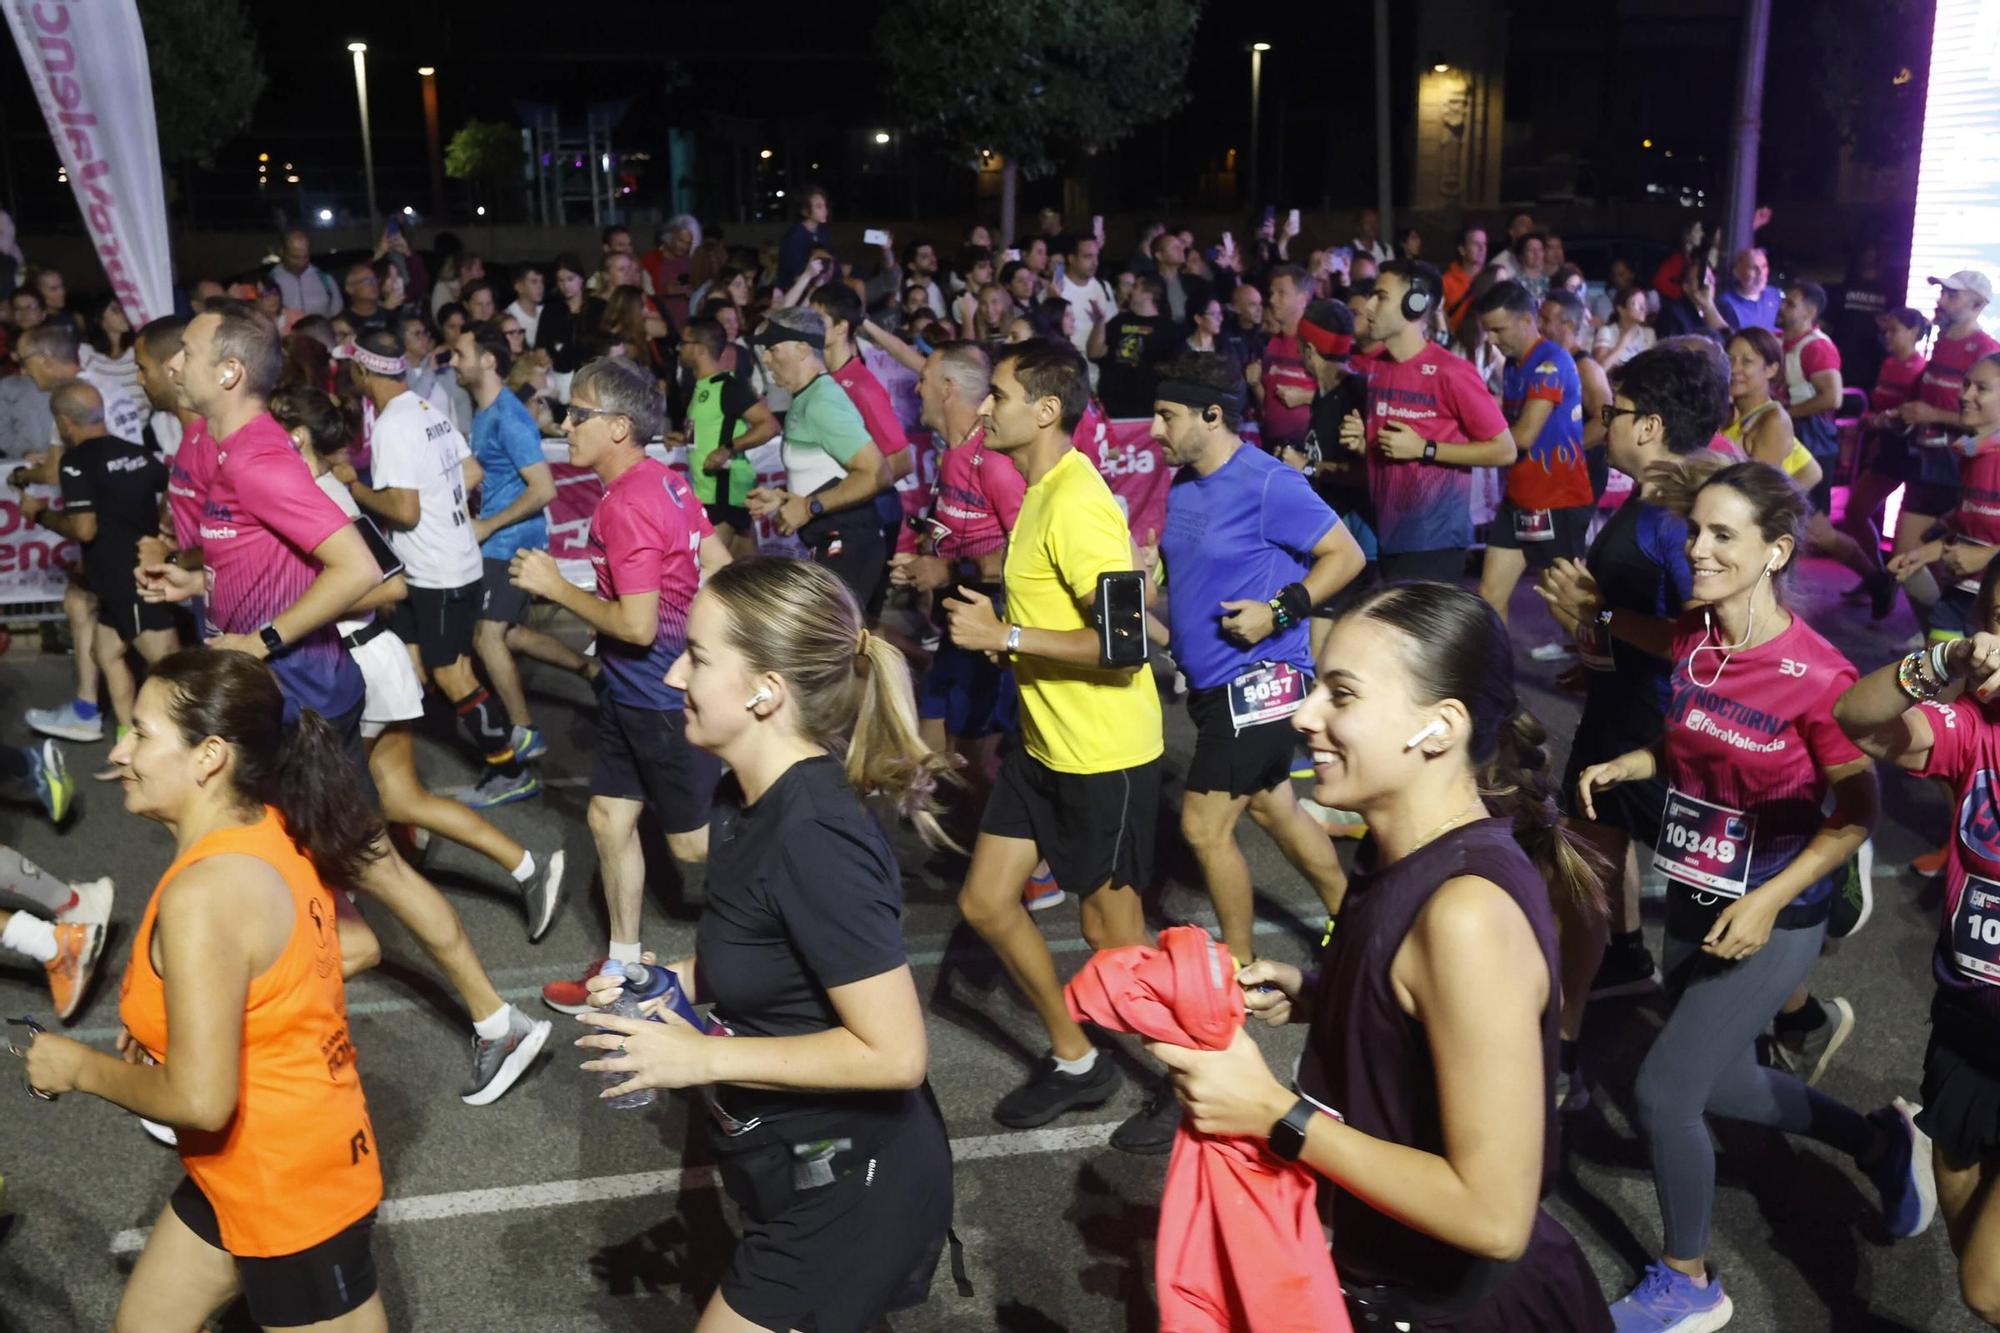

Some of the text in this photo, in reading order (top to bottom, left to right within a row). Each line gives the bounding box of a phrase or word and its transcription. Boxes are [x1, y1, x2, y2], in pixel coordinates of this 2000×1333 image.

[1243, 676, 1293, 703] 5057
[1701, 717, 1786, 753] fibraValencia
[1666, 822, 1736, 864] 10349
